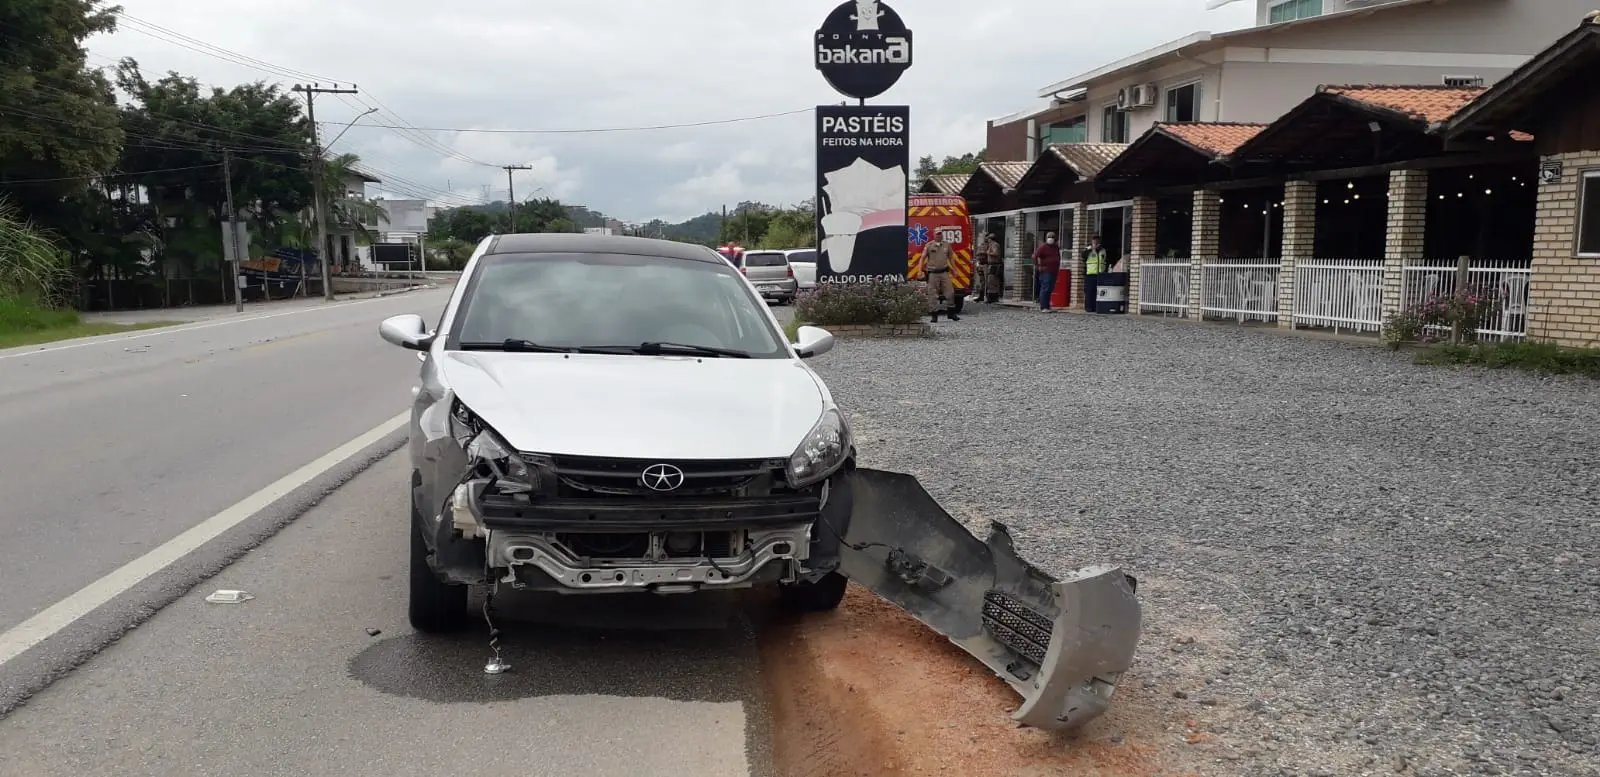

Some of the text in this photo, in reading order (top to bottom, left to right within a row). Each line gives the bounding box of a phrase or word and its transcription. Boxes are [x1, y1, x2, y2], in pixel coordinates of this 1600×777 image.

[822, 112, 904, 133] PASTÉIS
[822, 137, 904, 146] FEITOS NA HORA
[942, 230, 963, 244] 193
[820, 274, 857, 284] CALDO
[859, 274, 873, 284] DE
